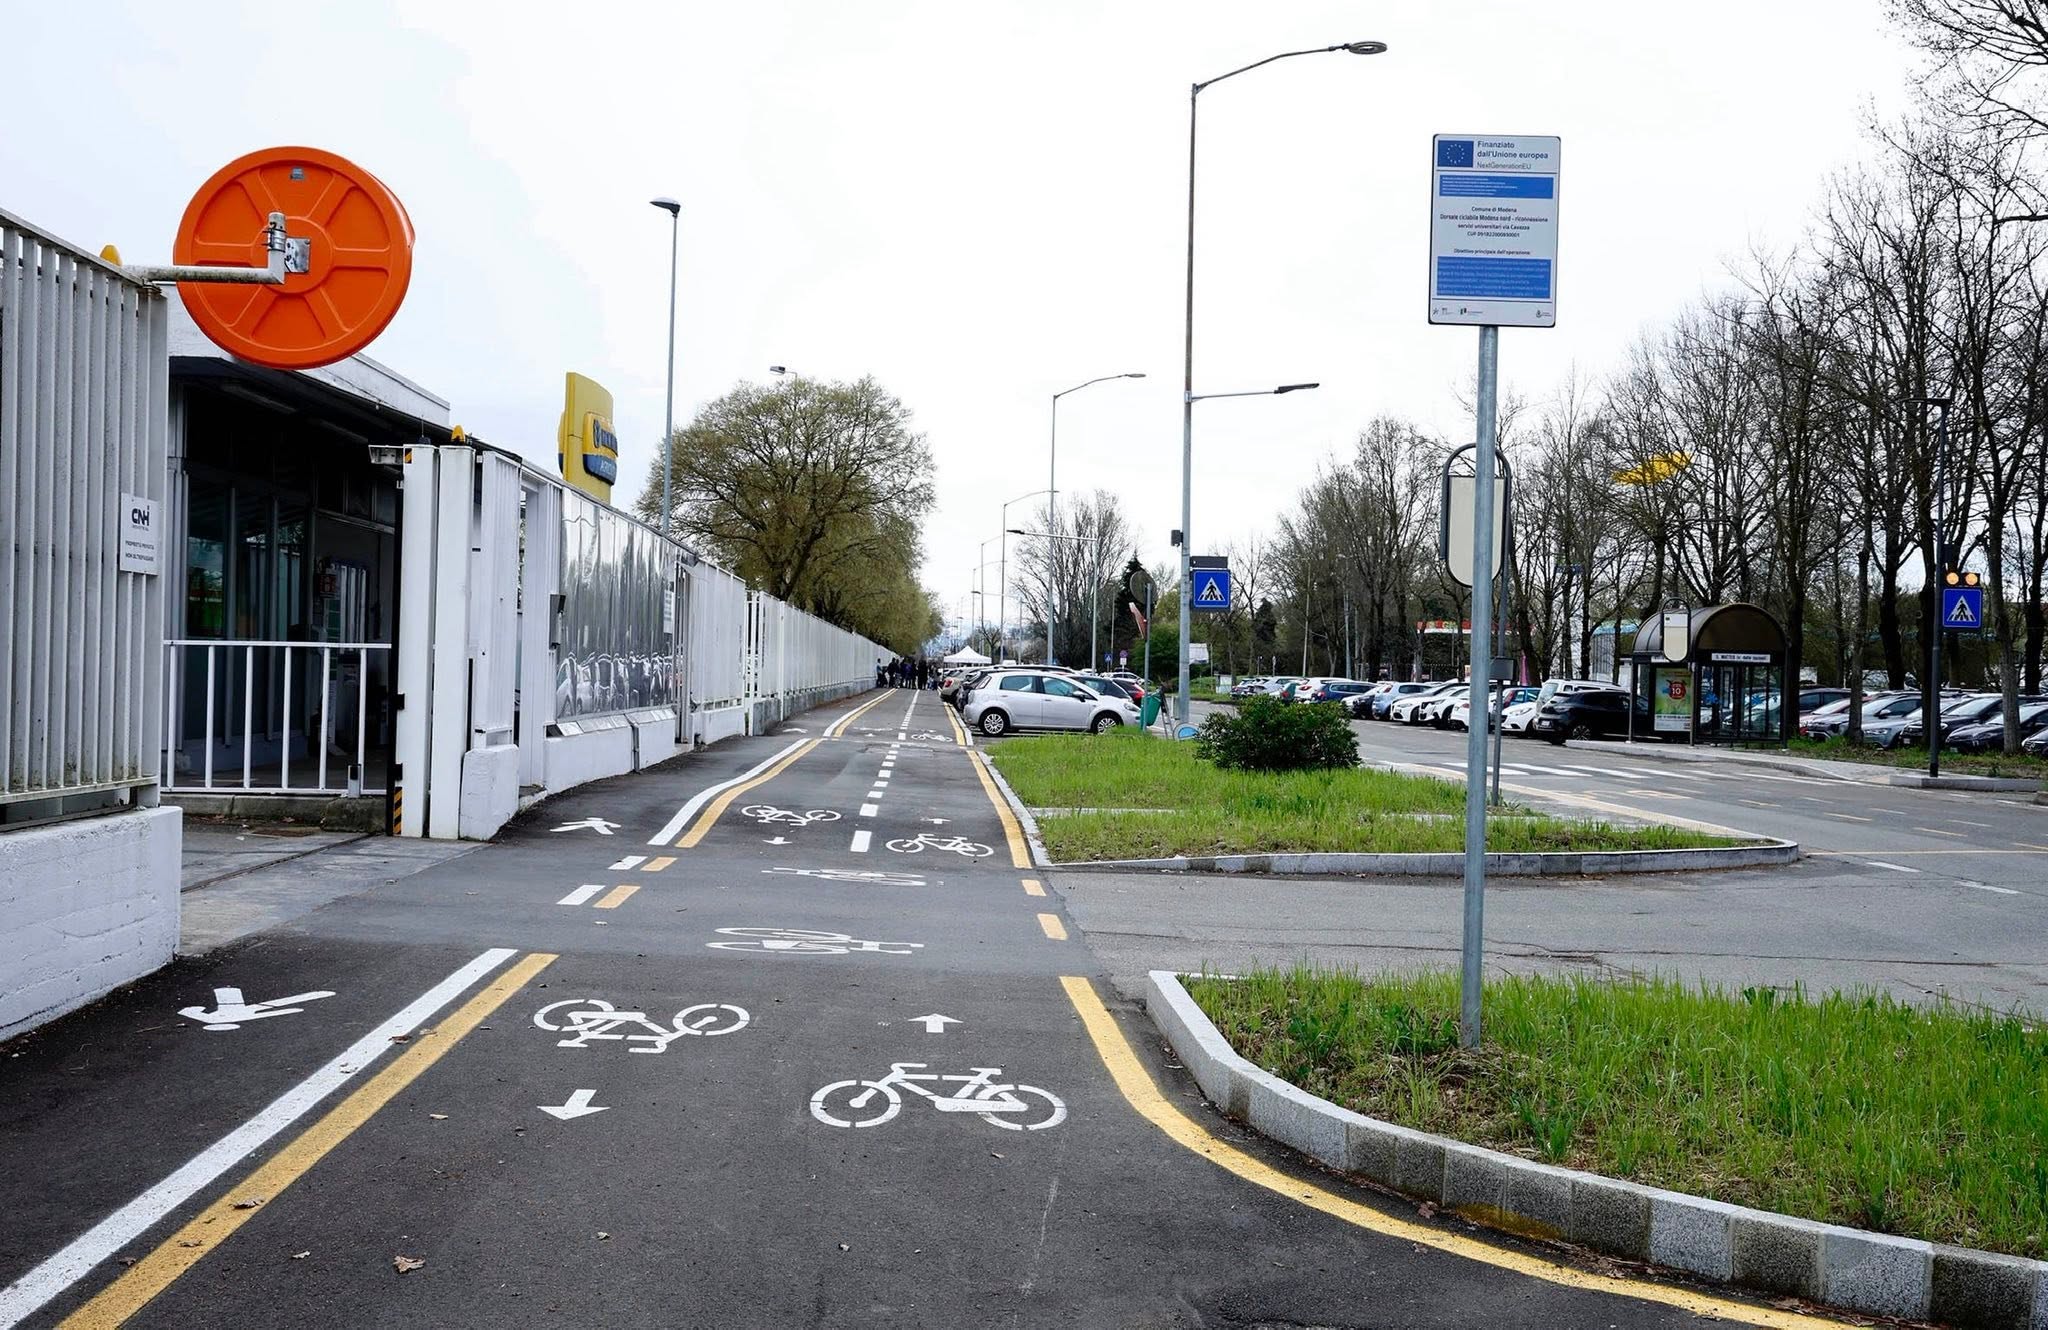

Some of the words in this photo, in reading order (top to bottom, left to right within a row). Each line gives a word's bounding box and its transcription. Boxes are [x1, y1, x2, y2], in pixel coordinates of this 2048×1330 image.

[1477, 141, 1515, 149] Finanziato
[1477, 150, 1517, 158] dall'Unione
[1519, 152, 1549, 160] europea
[1477, 162, 1532, 170] NextGenerationEU
